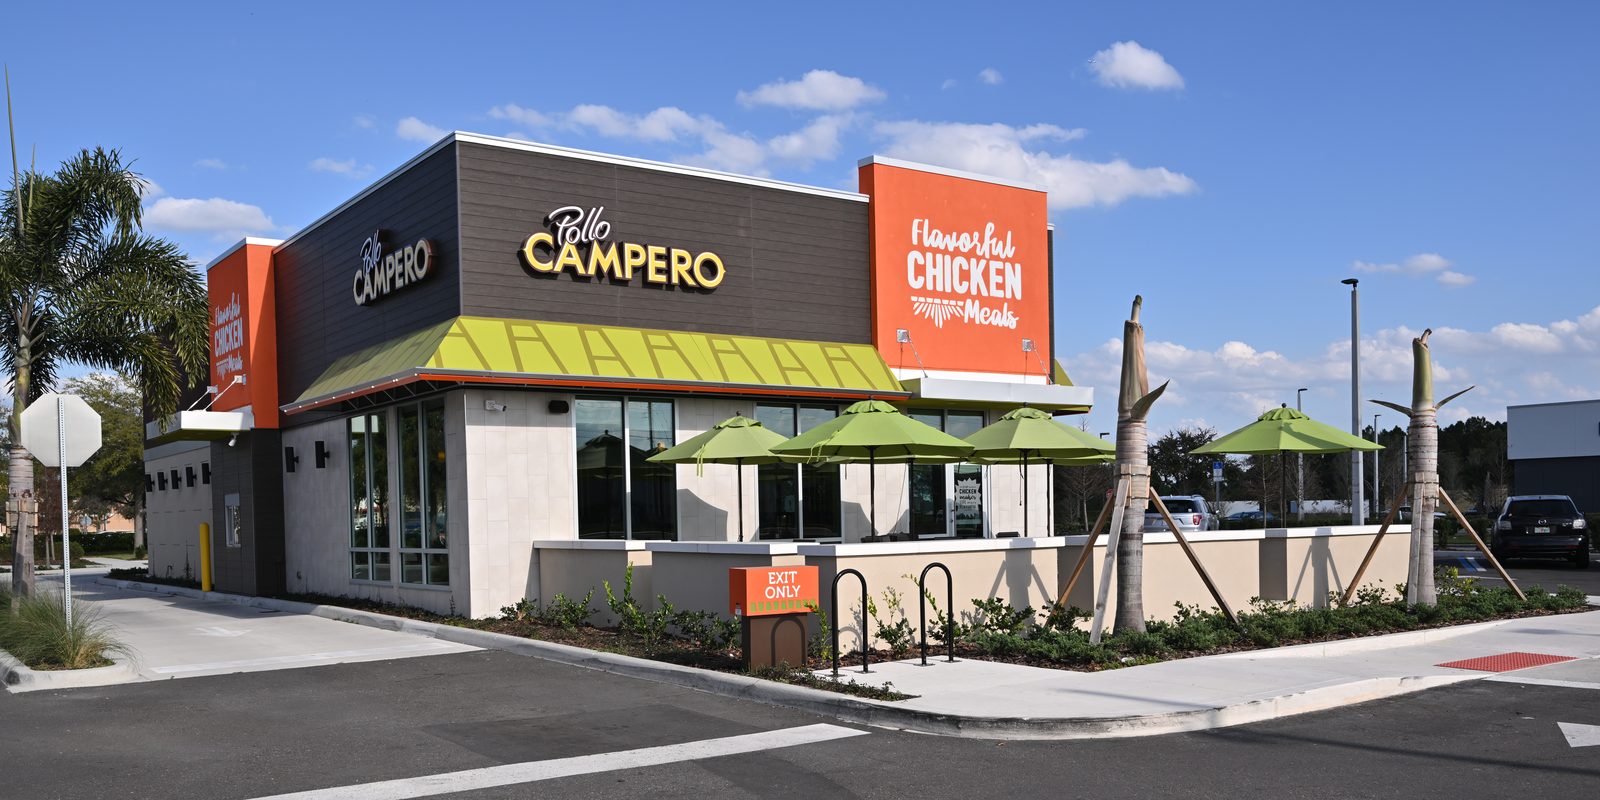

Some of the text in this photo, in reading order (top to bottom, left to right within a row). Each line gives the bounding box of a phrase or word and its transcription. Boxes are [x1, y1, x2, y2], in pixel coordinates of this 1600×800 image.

[548, 205, 611, 245] Pollo
[911, 218, 1016, 259] Flavorful
[353, 238, 432, 306] CAMPERO
[522, 231, 727, 290] CAMPERO
[907, 250, 1022, 300] CHICKEN
[964, 298, 1019, 330] Meals
[214, 317, 243, 358] CHICKEN
[765, 585, 801, 599] ONLY
[768, 571, 798, 585] EXIT
